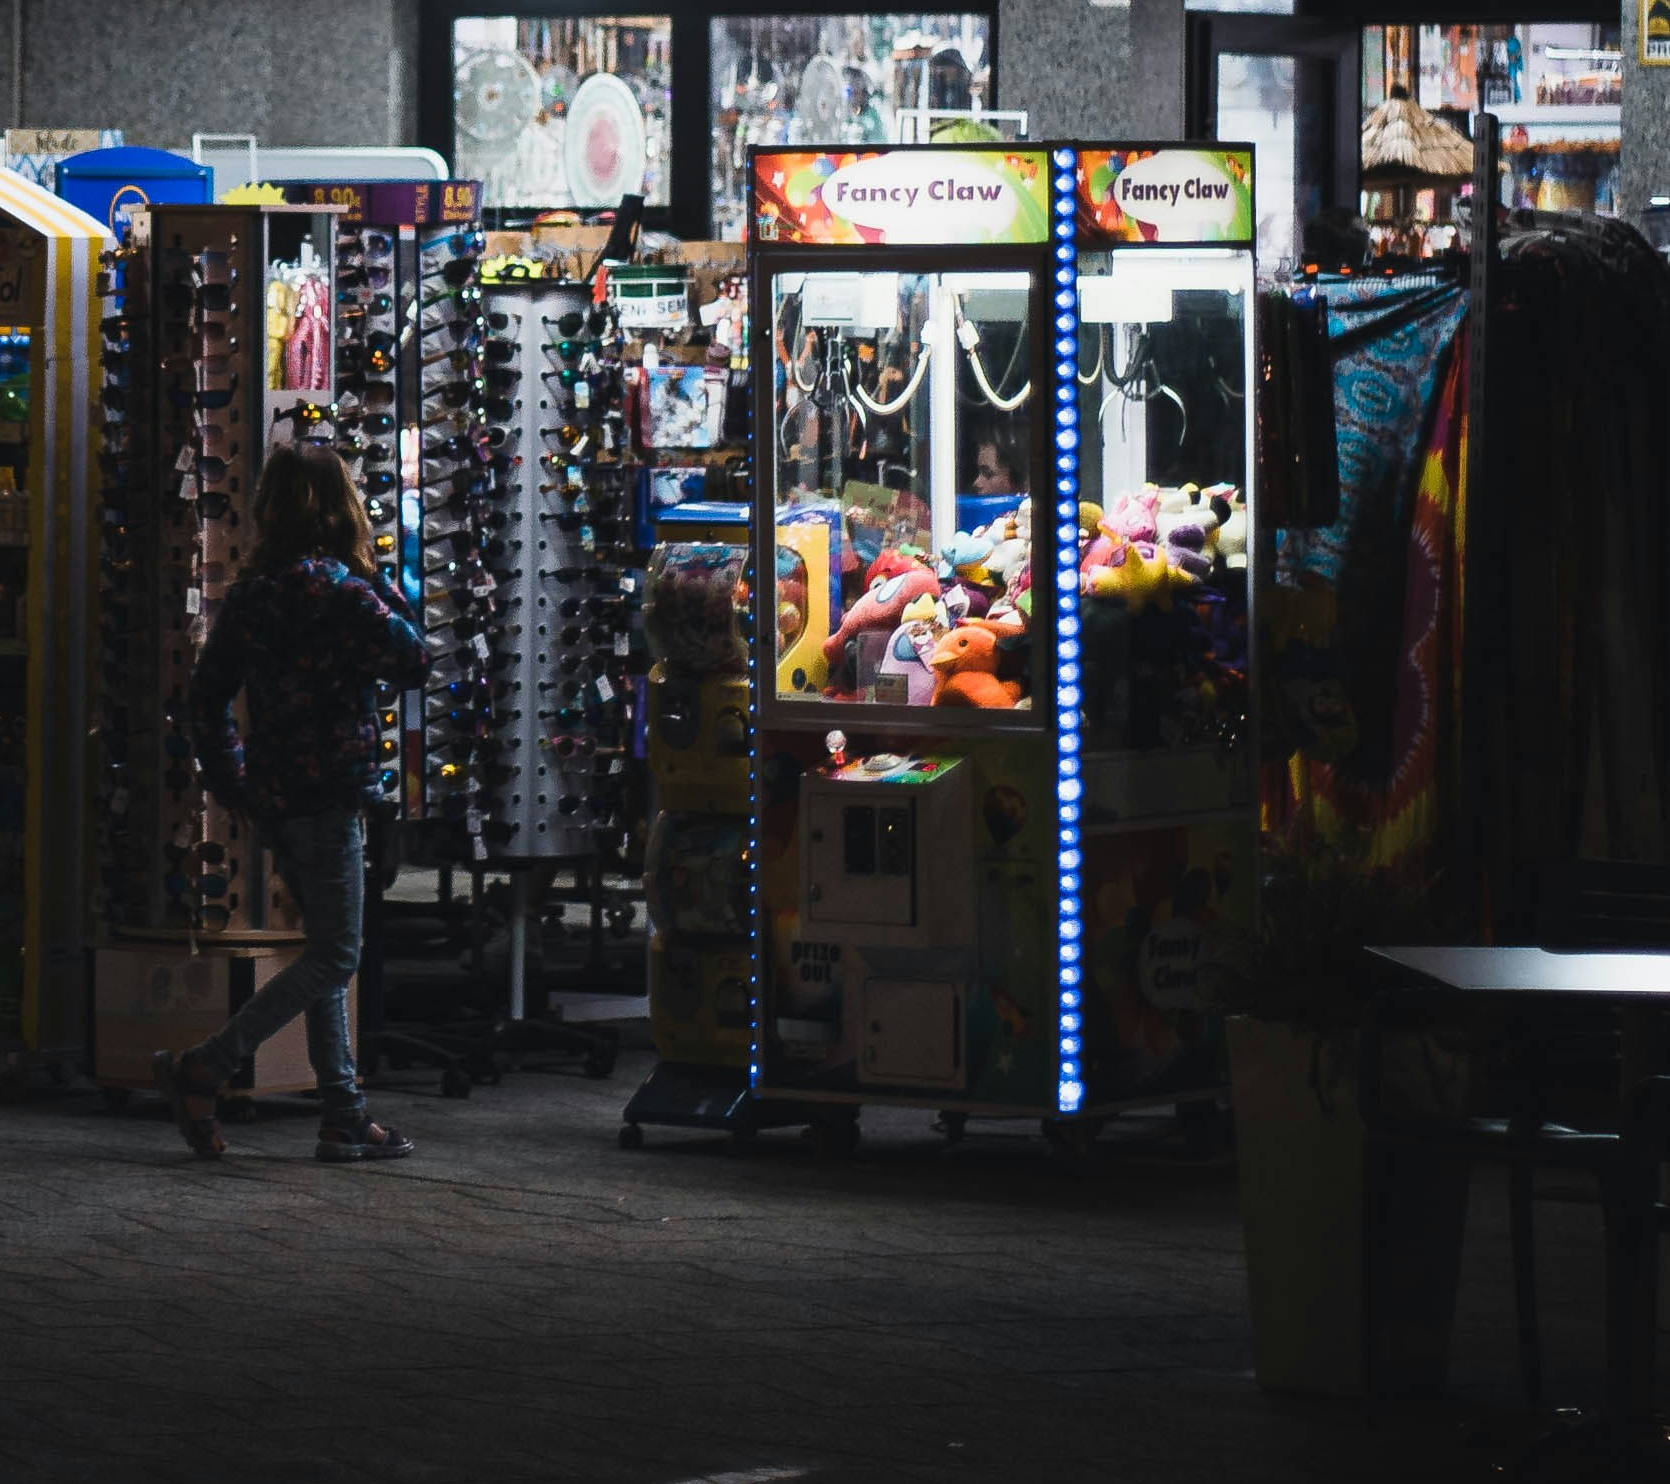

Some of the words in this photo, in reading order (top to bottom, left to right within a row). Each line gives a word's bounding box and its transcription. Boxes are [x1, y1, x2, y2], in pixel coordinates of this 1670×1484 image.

[836, 181, 919, 208] Fancy
[928, 178, 1003, 202] Claw
[1121, 178, 1181, 207] Fancy
[1184, 178, 1230, 200] Claw
[791, 941, 841, 963] prize
[801, 963, 832, 983] out
